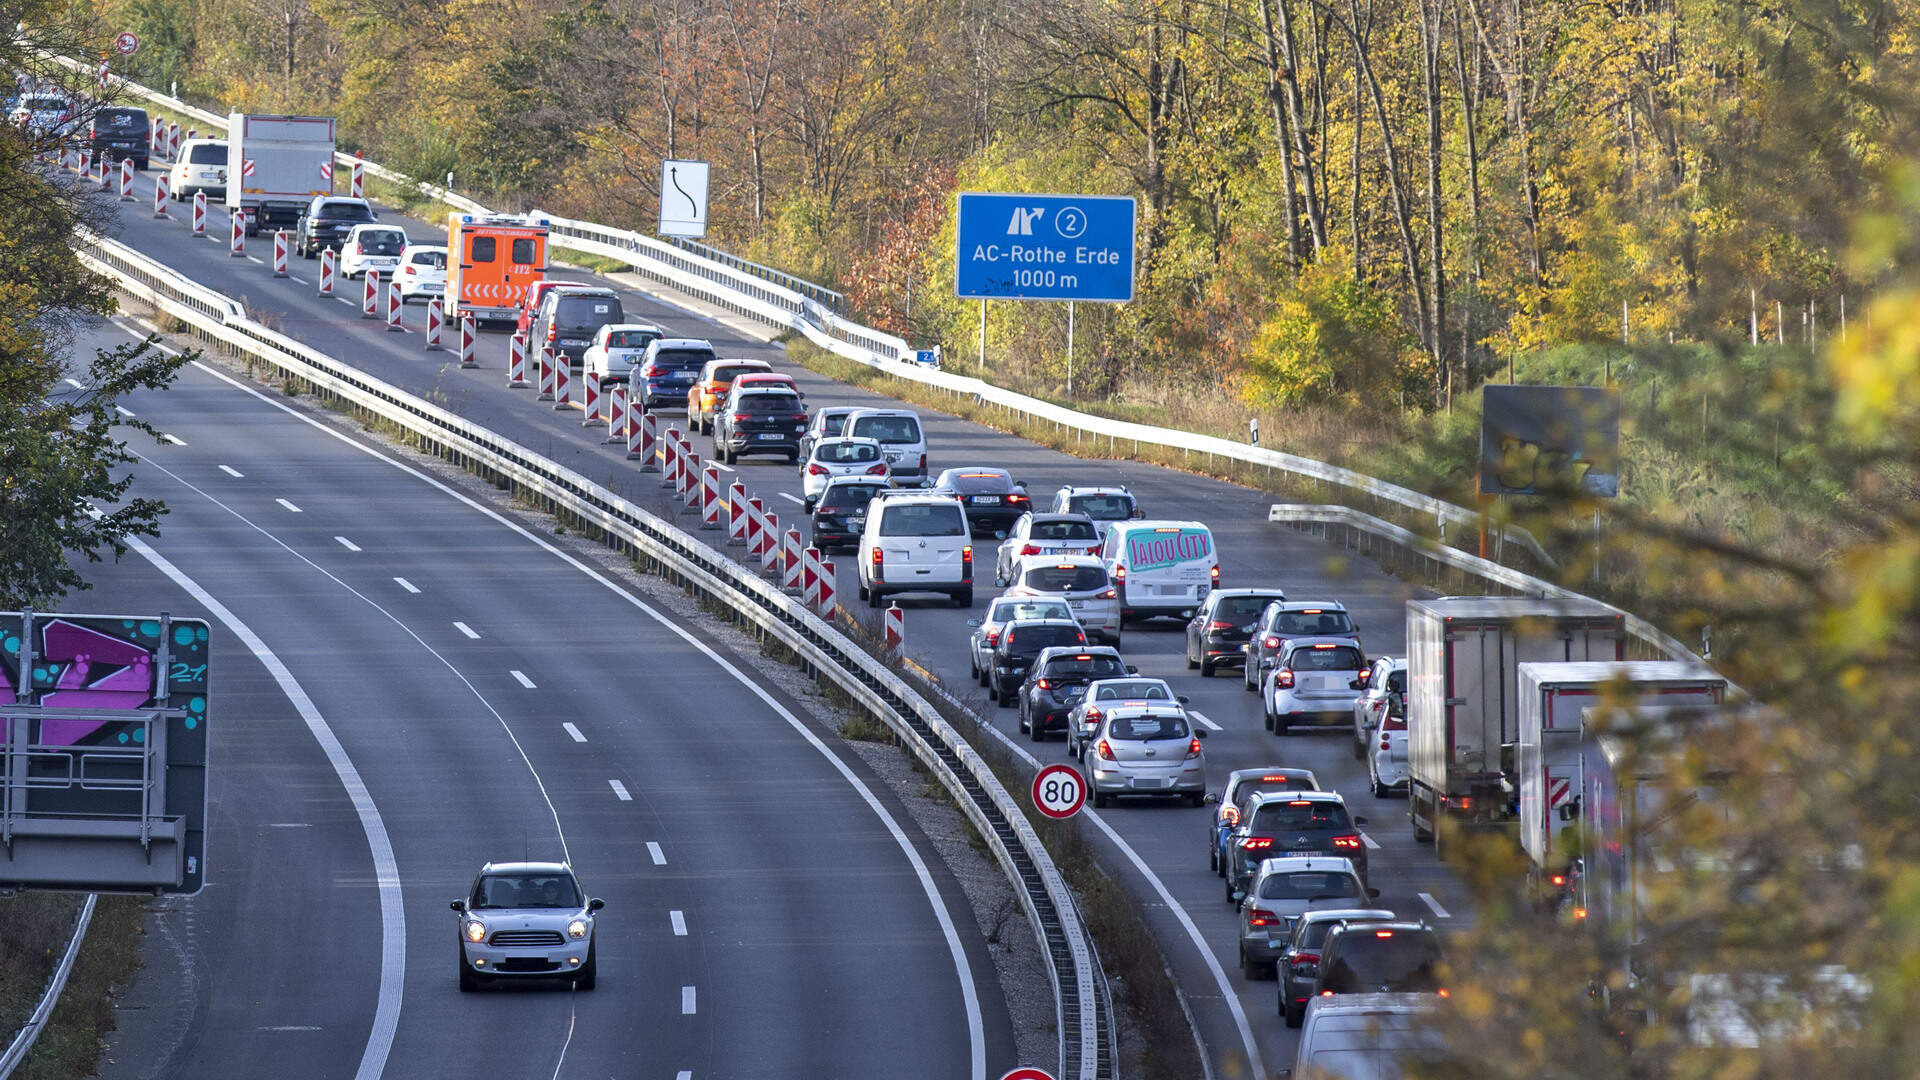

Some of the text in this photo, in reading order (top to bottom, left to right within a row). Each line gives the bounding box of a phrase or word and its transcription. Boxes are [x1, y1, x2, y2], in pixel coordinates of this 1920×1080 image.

[1065, 214, 1076, 231] 2
[972, 244, 1120, 265] AC-Rothe Erde
[514, 265, 530, 275] 112
[1013, 270, 1055, 287] 1000
[1060, 275, 1077, 288] m
[1045, 780, 1074, 804] 80
